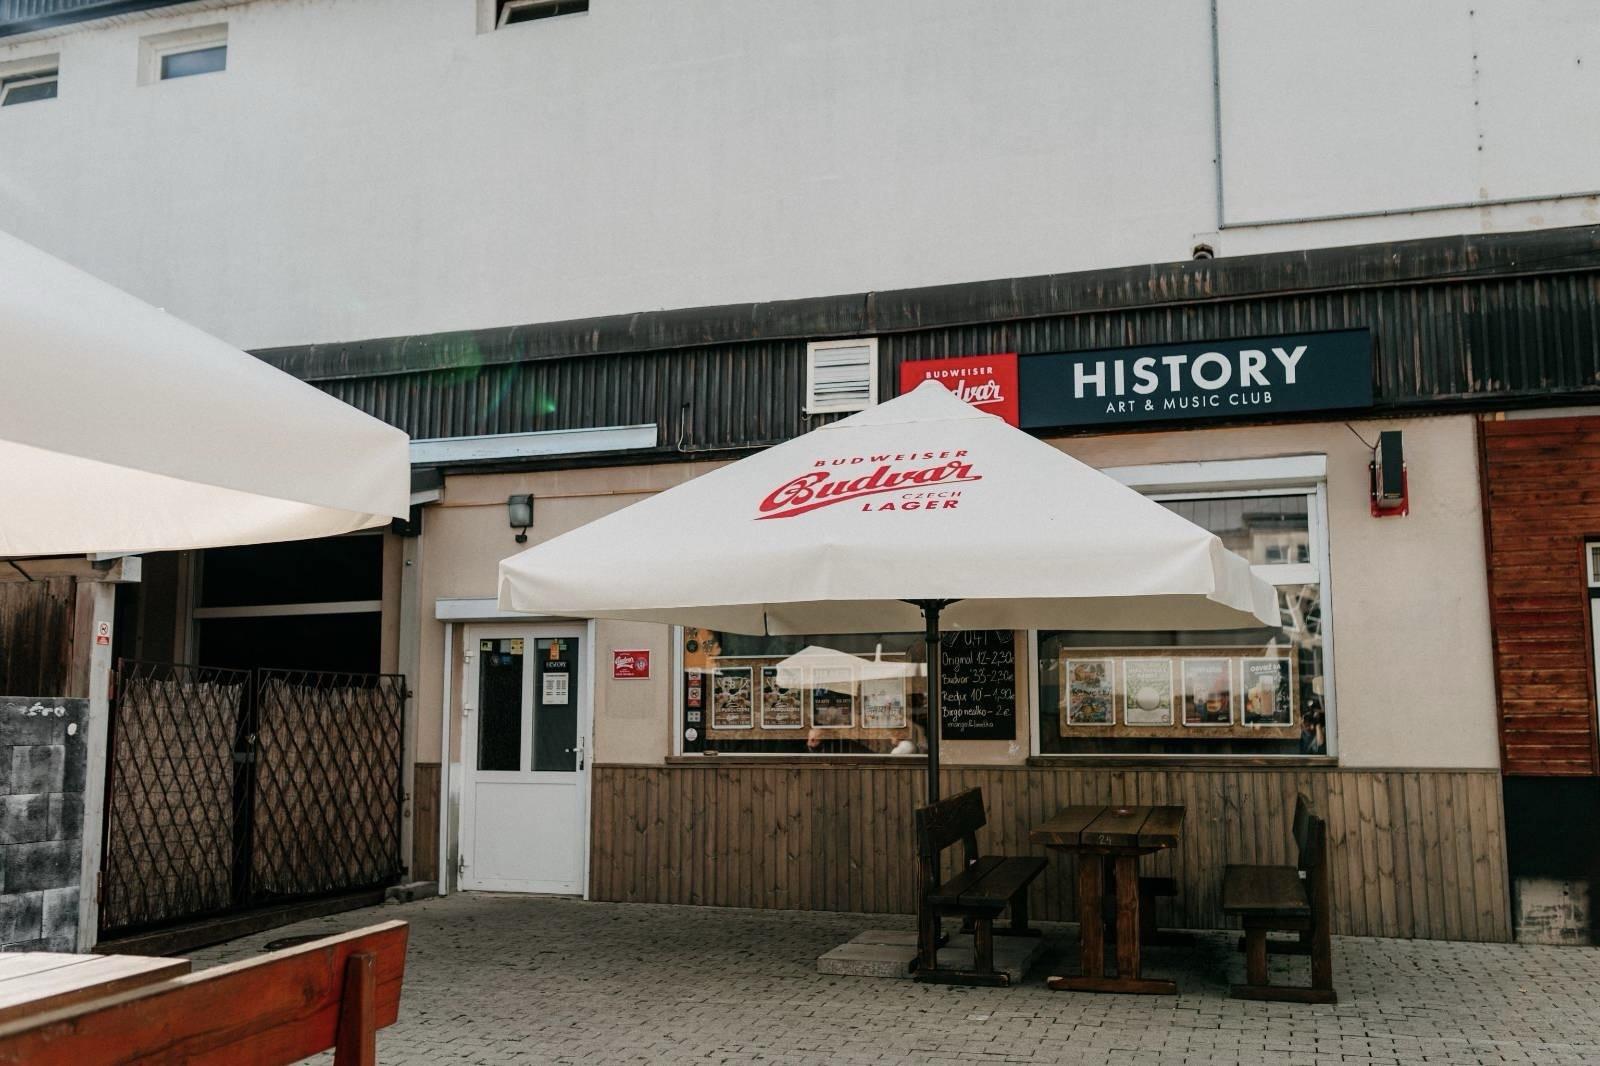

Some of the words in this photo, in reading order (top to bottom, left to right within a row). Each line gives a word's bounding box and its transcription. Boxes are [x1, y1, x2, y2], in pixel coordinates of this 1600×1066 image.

[925, 366, 993, 379] BUDWEISER
[1073, 345, 1308, 398] HISTORY
[951, 380, 1003, 404] dvar
[1105, 400, 1134, 413] ART
[1144, 399, 1154, 412] &
[1164, 395, 1220, 410] MUSIC
[1228, 392, 1272, 405] CLUB
[814, 450, 968, 467] BUDWEISER
[755, 461, 982, 515] Budvar
[902, 491, 962, 499] CZECH
[861, 500, 959, 512] LAGER
[942, 649, 973, 673] Original
[1098, 834, 1112, 846] 24
